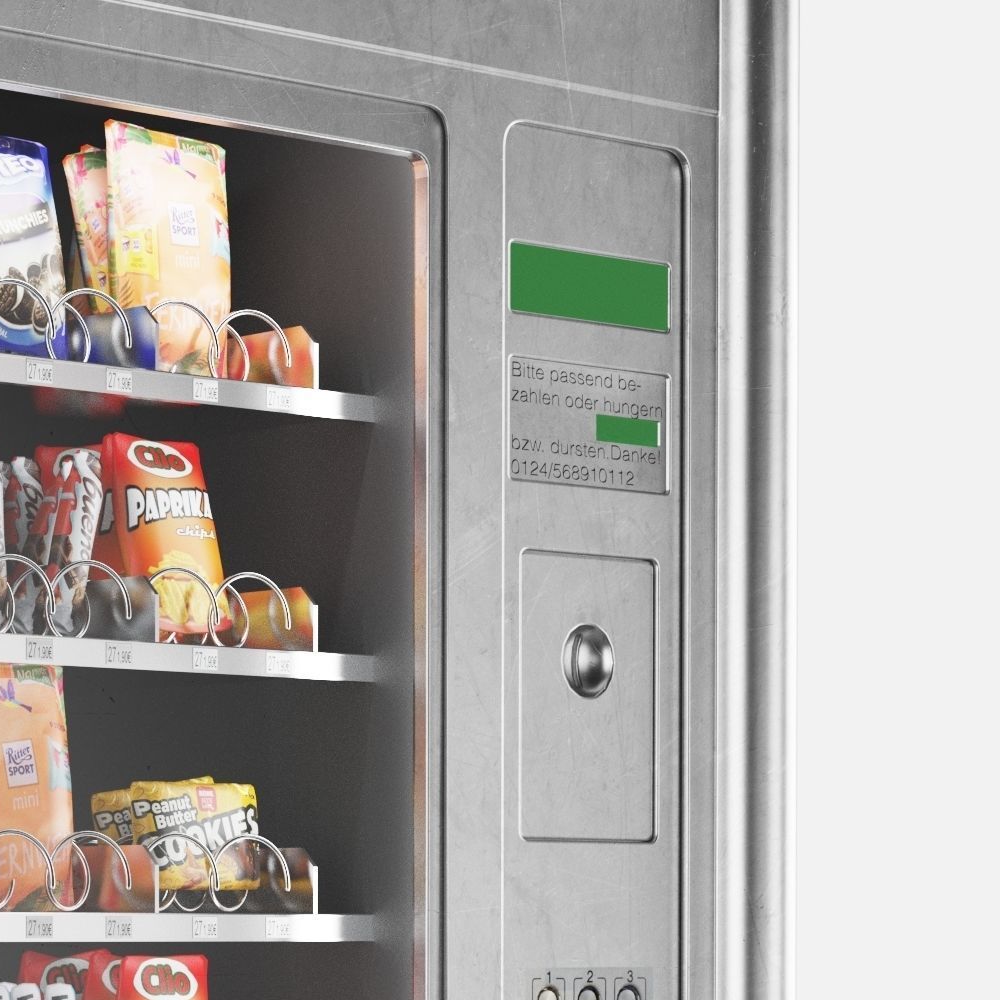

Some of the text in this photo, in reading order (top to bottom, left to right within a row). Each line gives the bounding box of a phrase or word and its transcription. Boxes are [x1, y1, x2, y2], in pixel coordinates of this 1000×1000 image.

[172, 224, 196, 236] SPORT
[511, 361, 642, 392] Bitte passend be-
[511, 389, 663, 419] zahlen oder hungern
[511, 435, 544, 453] bzw.
[511, 459, 635, 486] 0124/568910112
[126, 485, 214, 531] PAPRIKA
[5, 747, 33, 765] Ritter
[8, 764, 34, 776] SPORT
[12, 790, 39, 810] mini
[133, 794, 192, 817] Peanut
[154, 808, 198, 830] Butter
[142, 807, 259, 867] COOKIES
[546, 971, 633, 984] 1 2 3
